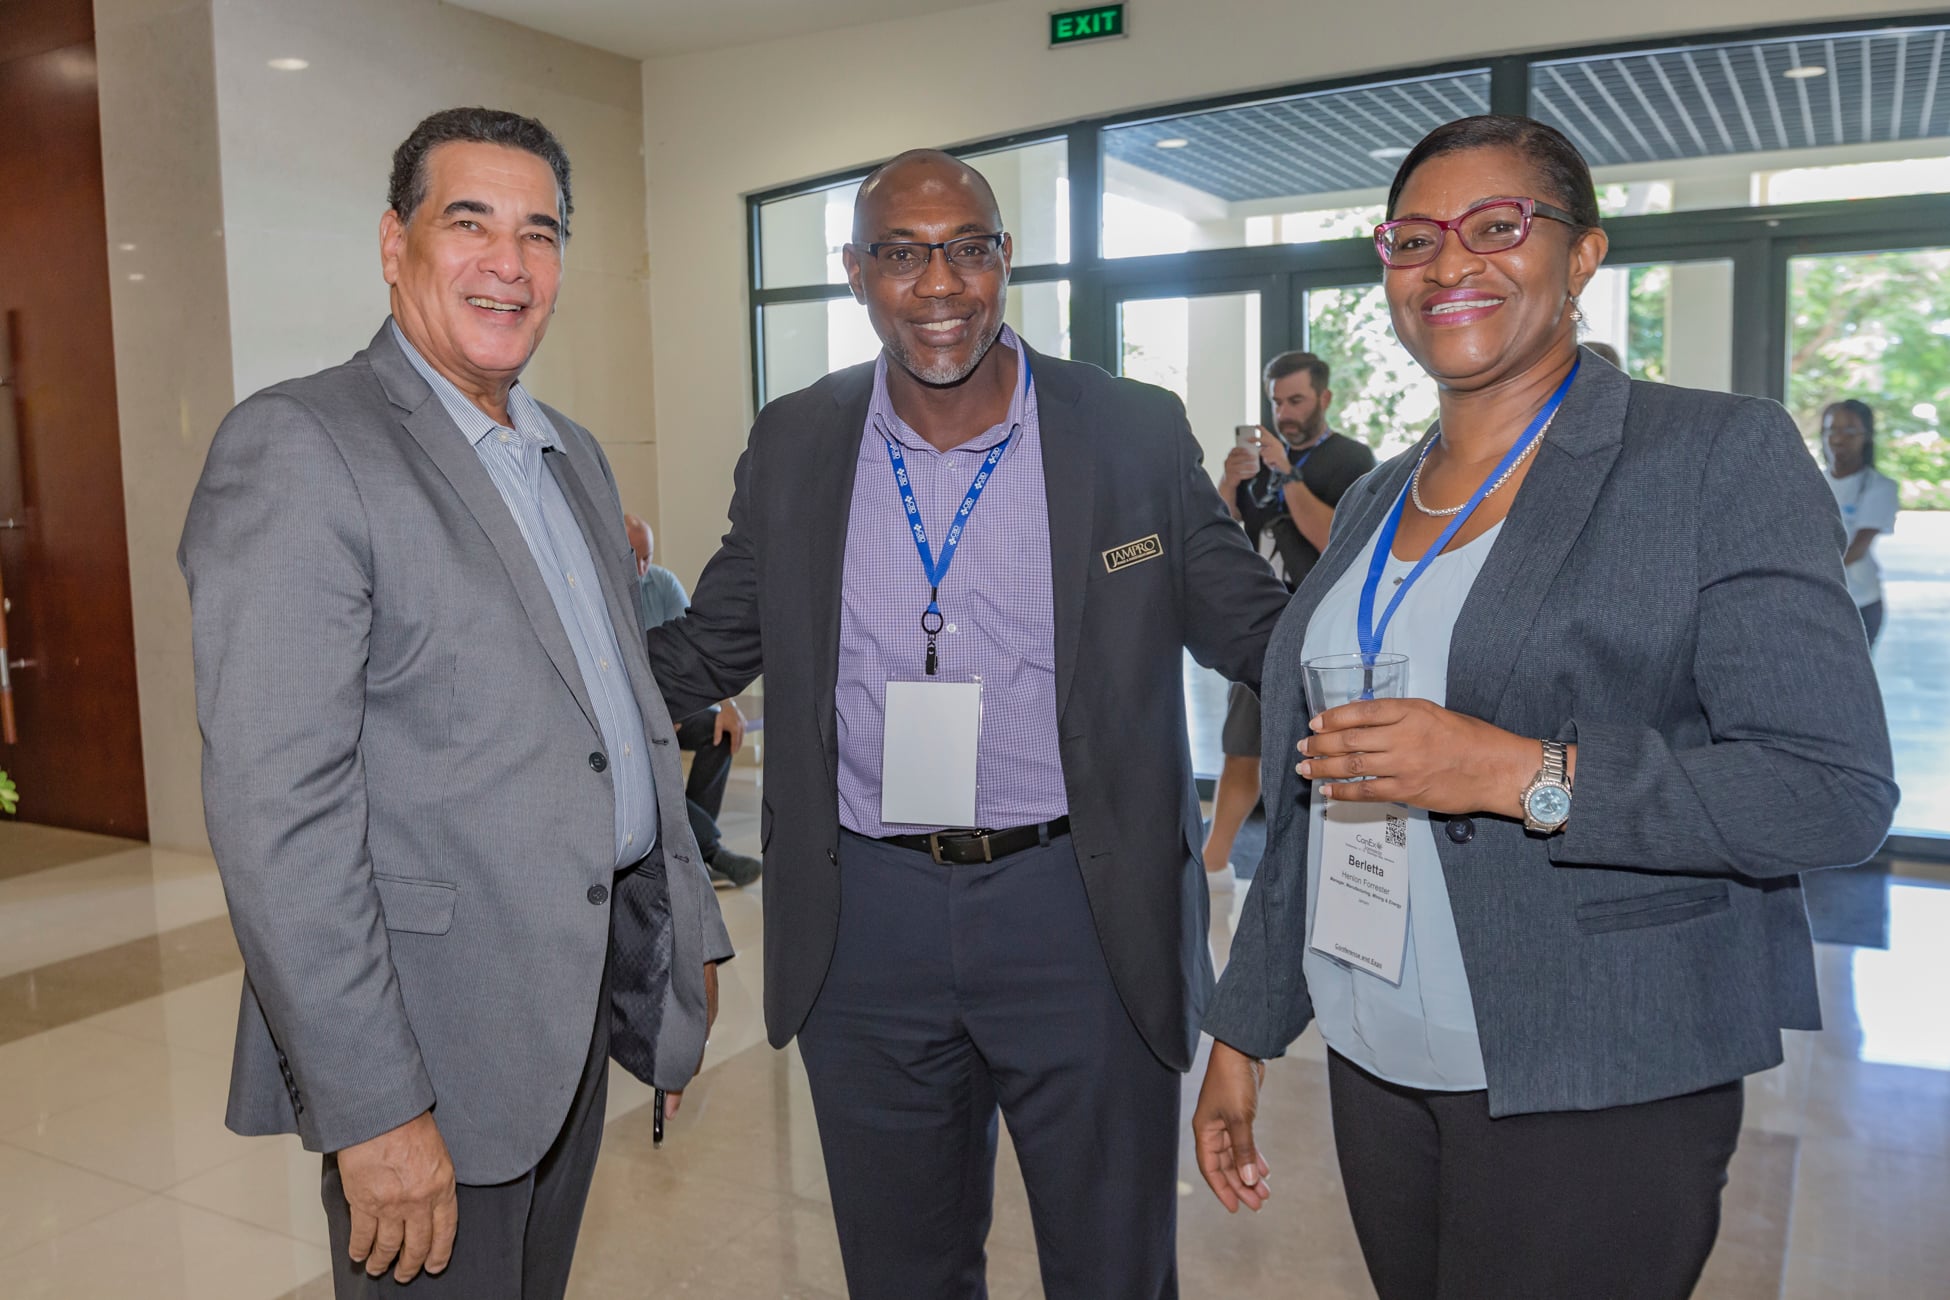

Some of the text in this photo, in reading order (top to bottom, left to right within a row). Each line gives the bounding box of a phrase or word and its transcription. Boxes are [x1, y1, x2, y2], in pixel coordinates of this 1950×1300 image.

[1057, 11, 1117, 38] EXIT
[1111, 540, 1155, 567] JAMPRO
[1348, 854, 1384, 877] Berletta
